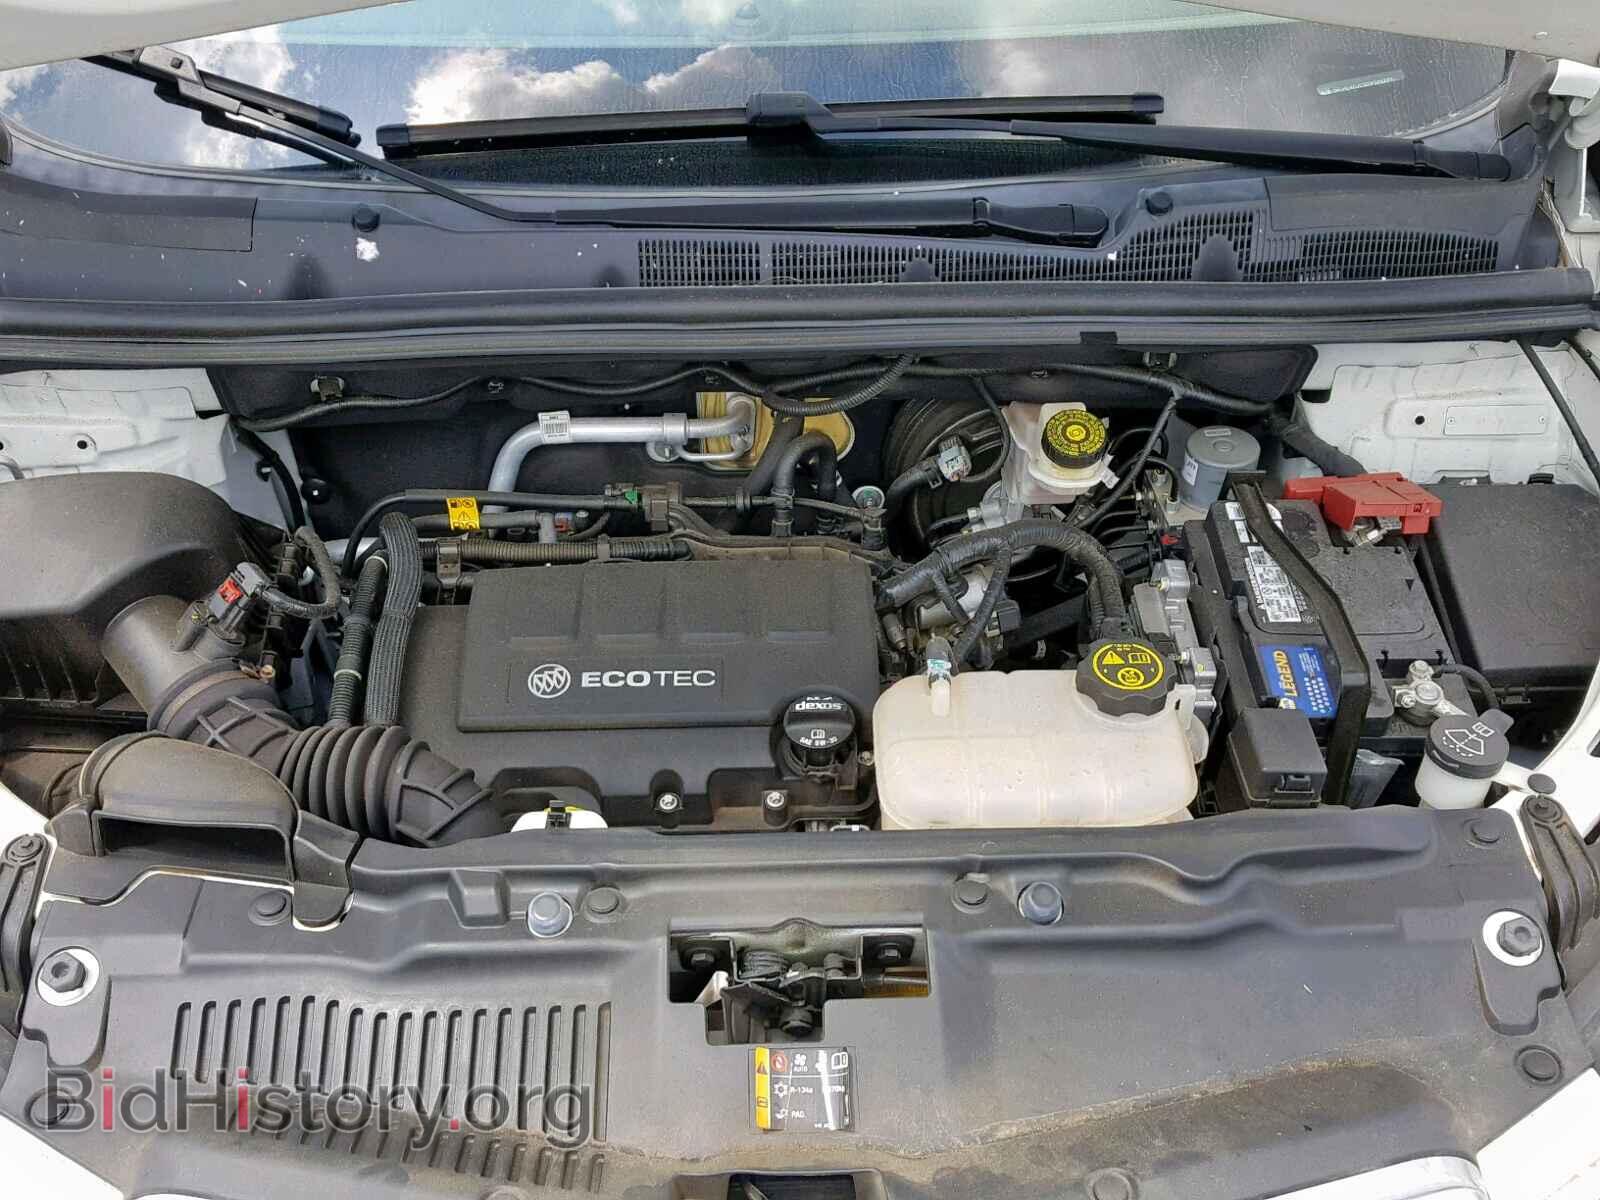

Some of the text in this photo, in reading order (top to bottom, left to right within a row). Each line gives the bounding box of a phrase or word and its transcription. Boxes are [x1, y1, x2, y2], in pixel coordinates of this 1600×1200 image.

[581, 670, 716, 688] ECOTEC
[1273, 650, 1298, 697] LEGEND
[795, 701, 842, 711] dexos
